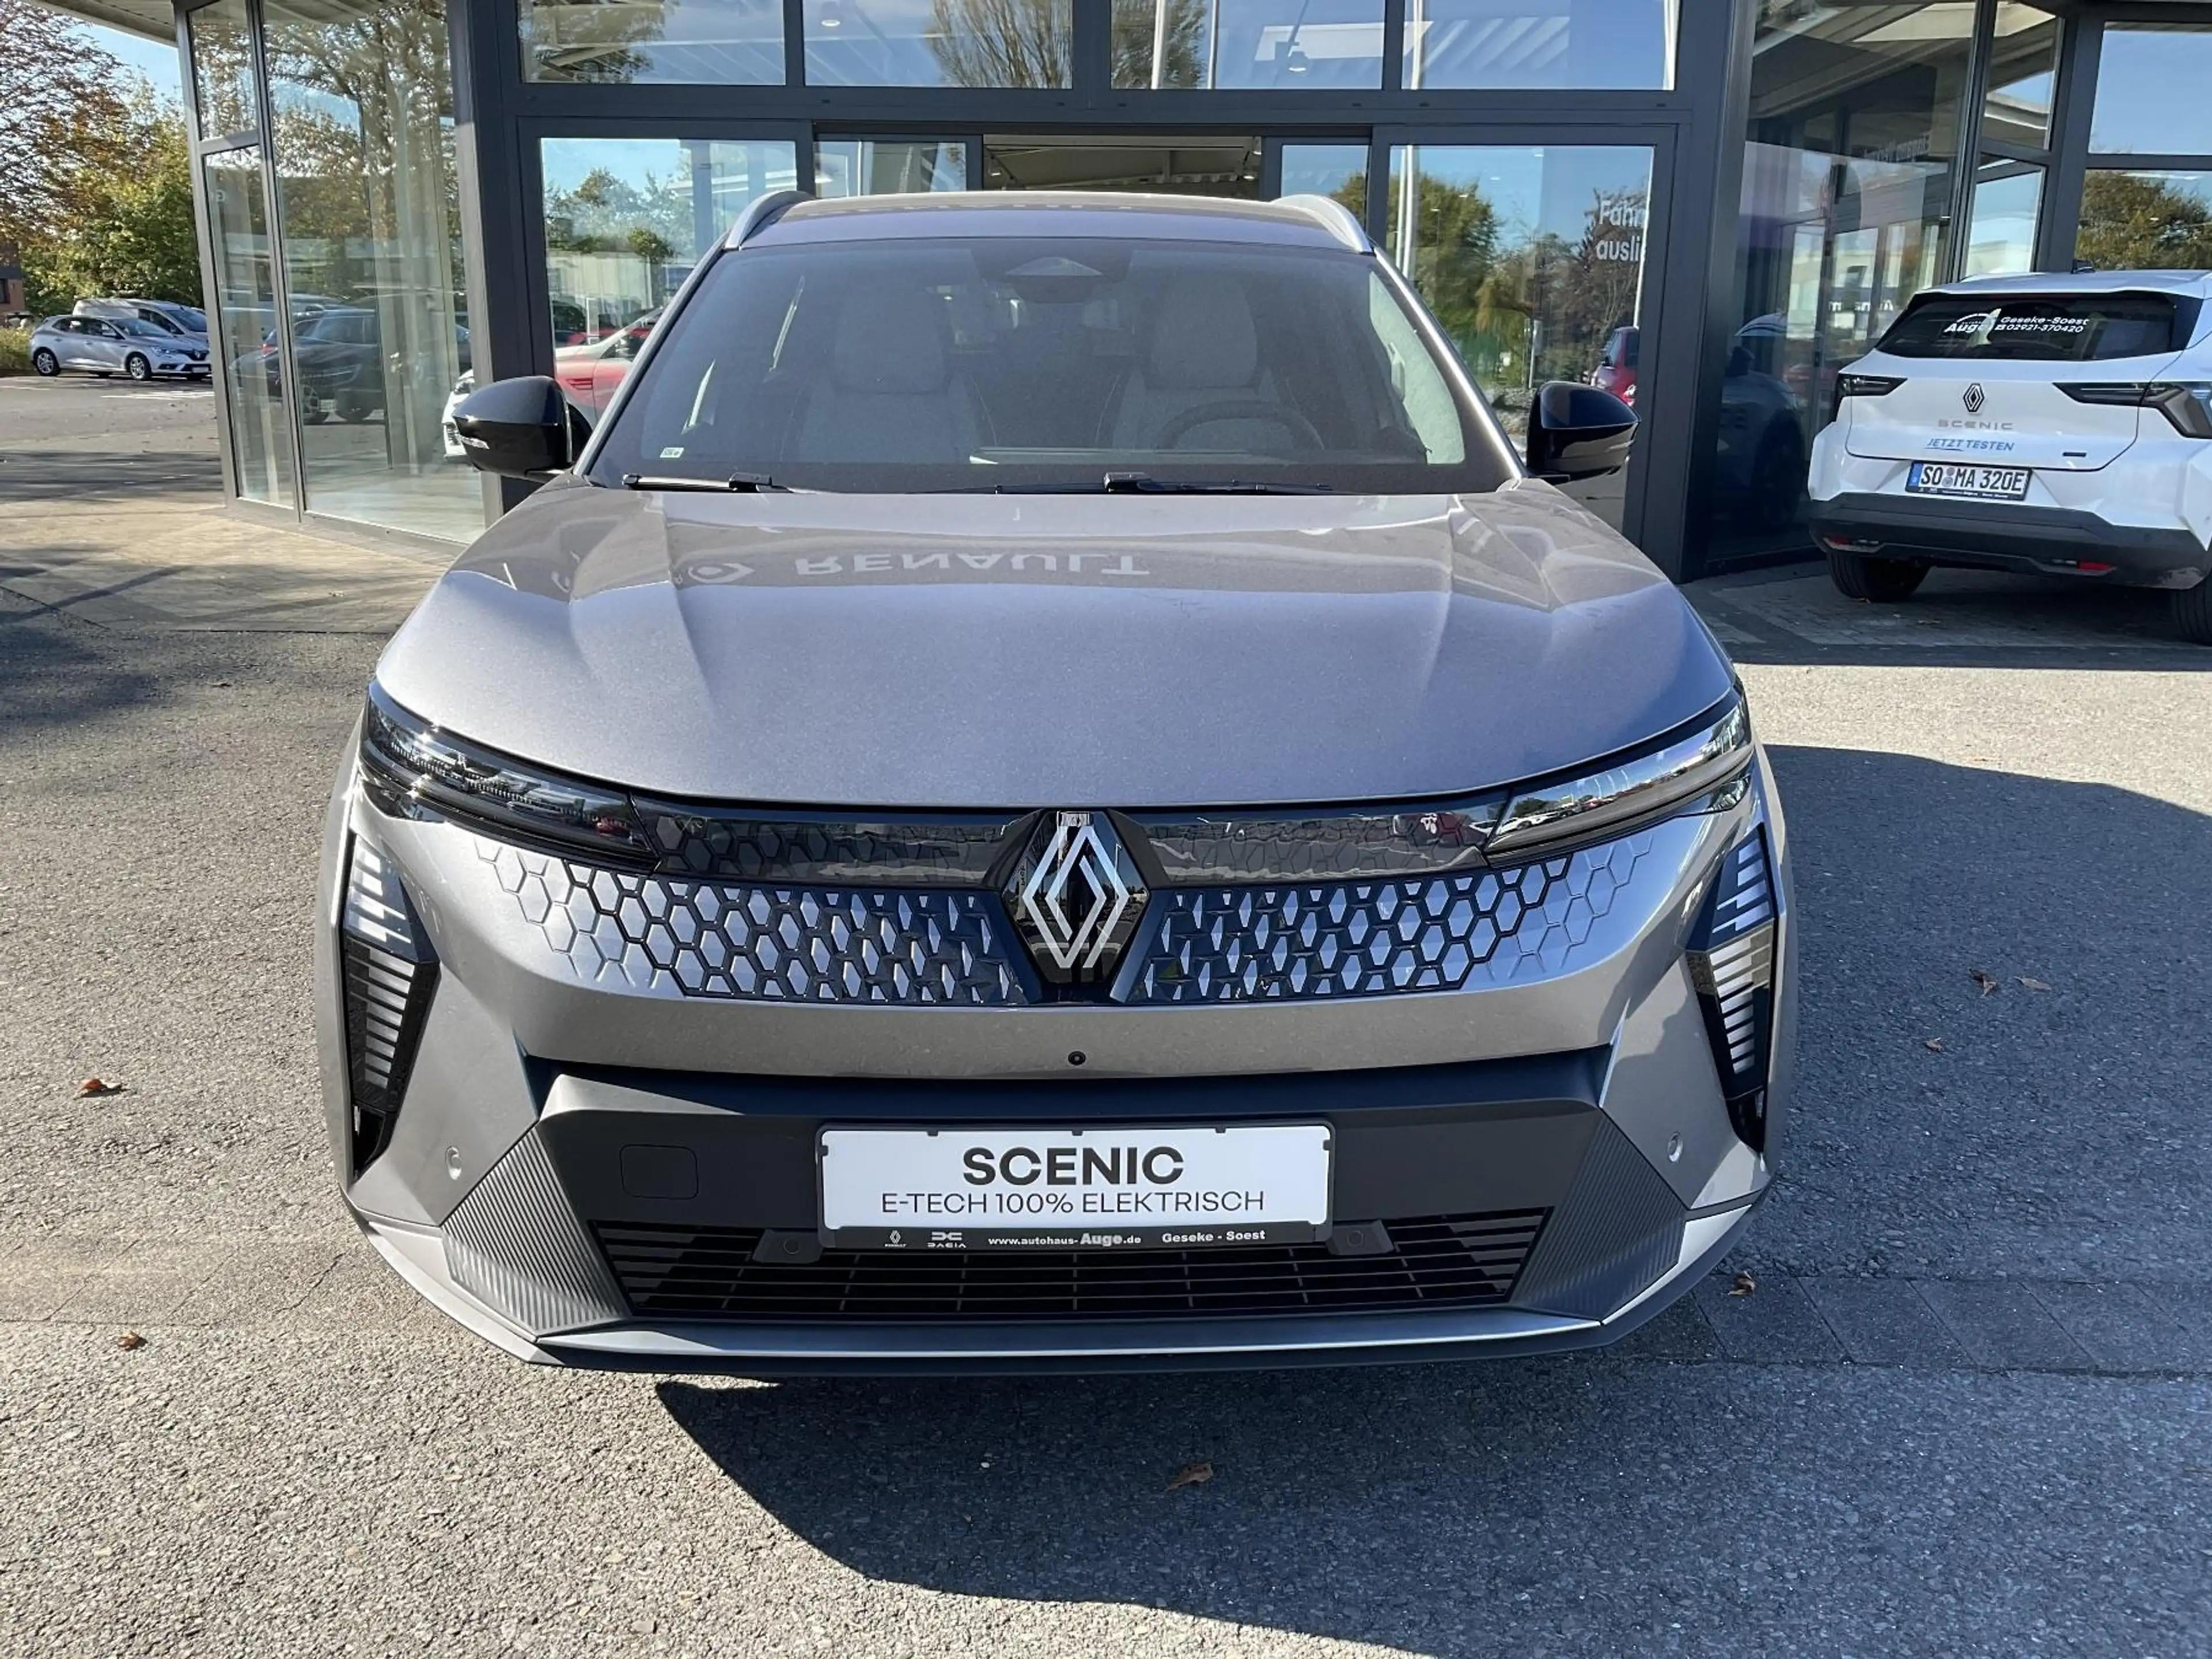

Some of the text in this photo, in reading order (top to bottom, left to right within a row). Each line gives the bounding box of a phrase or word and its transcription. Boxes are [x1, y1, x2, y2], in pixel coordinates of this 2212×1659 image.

[2006, 324, 2084, 333] 02921-370420
[1938, 419, 2014, 430] SCENIC
[1927, 438, 2015, 451] JETZT TESTEN
[1921, 466, 2025, 492] SO MA 320E
[963, 1146, 1184, 1186] SCENIC
[882, 1191, 1264, 1214] E-TECH 100% ELEKTRISCH
[988, 1232, 1141, 1247] www.autohaus-Auge.de
[1162, 1230, 1214, 1244] Geseke
[1226, 1229, 1266, 1242] Soest
